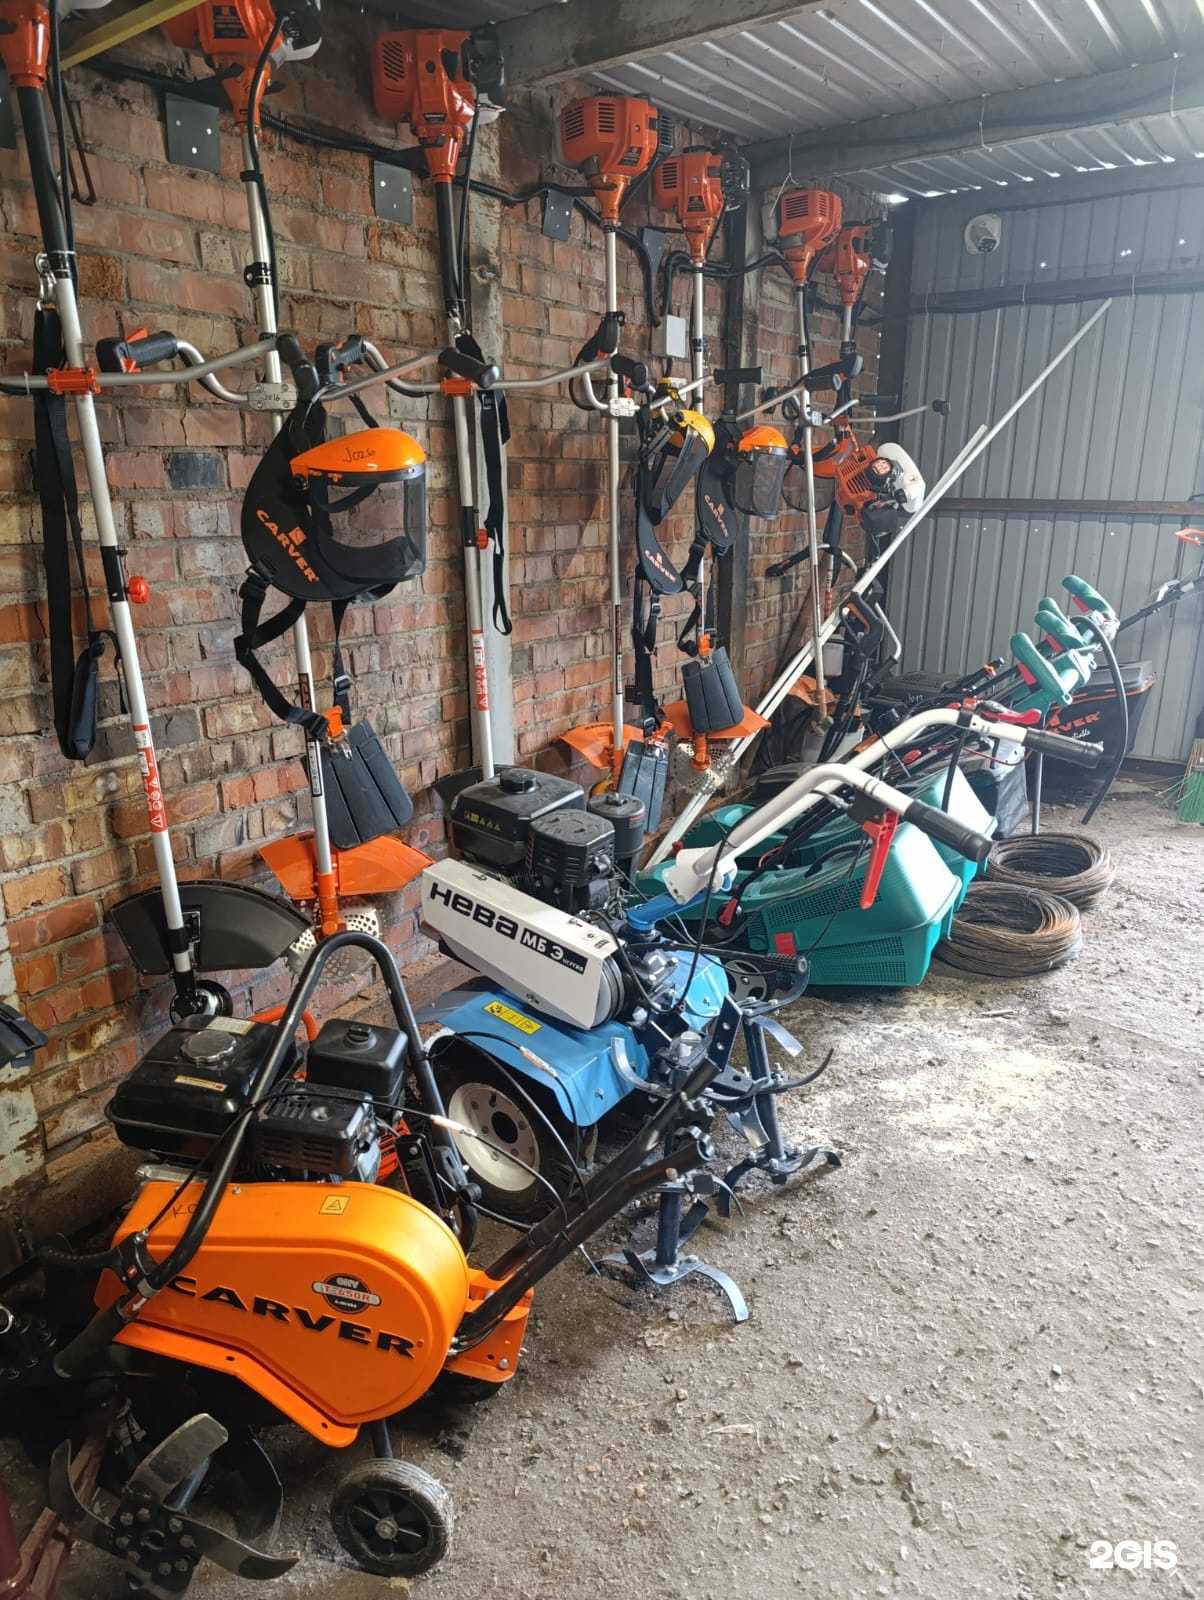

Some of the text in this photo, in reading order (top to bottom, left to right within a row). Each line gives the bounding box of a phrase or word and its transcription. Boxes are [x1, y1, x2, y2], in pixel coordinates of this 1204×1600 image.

[256, 509, 320, 583] CARVER
[430, 882, 519, 940] Нева
[522, 931, 547, 953] МБ
[166, 1274, 417, 1359] CARVER
